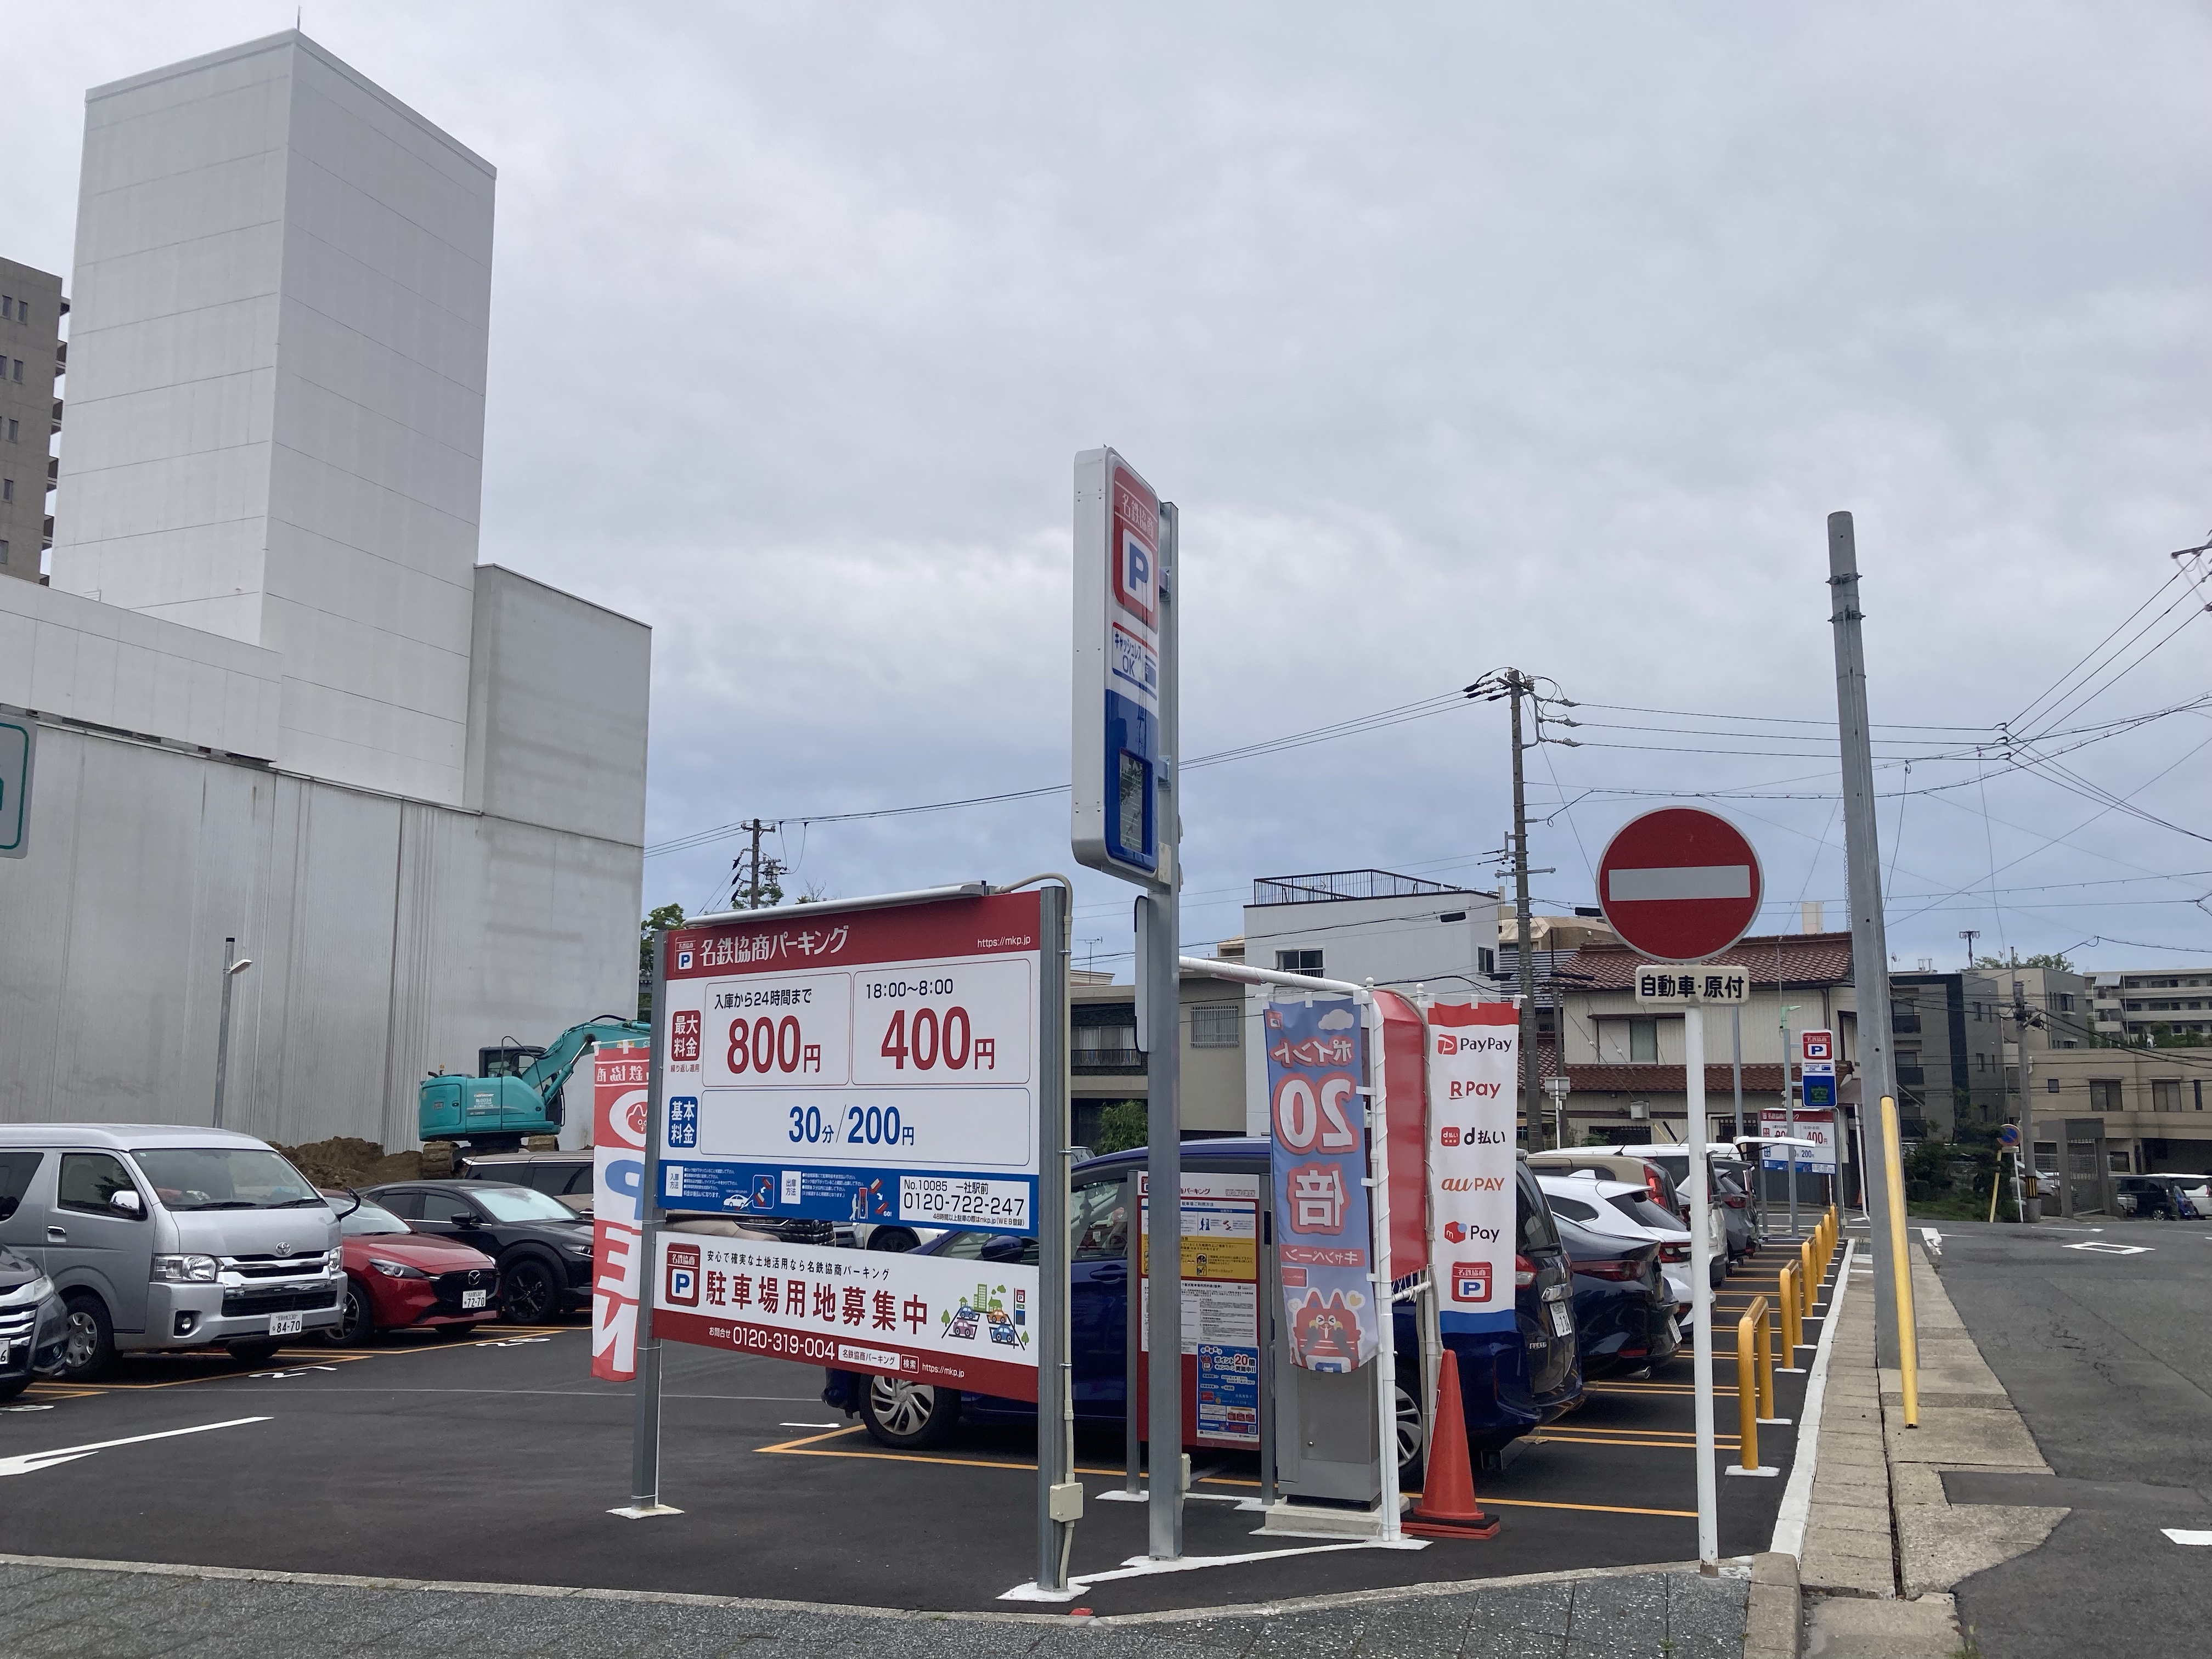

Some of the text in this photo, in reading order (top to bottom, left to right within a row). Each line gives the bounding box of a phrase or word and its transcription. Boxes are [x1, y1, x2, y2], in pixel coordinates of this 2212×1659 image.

[1121, 493, 1154, 540] 名鉄協商
[1129, 541, 1149, 591] P
[1115, 630, 1141, 663] キャッシュレス
[1122, 654, 1135, 678] OK
[699, 925, 849, 967] 名鉄協商パーキング
[977, 934, 1031, 949] https://mkp.jp
[681, 954, 690, 968] P
[1641, 974, 1745, 998] 自動車・原付
[714, 988, 812, 1010] 入庫から24時間まで
[674, 1014, 698, 1035] 最大
[673, 1036, 698, 1058] 料金
[727, 1015, 821, 1074] 800円
[881, 1006, 995, 1070] 400円
[1460, 1037, 1512, 1053] PayPay
[1811, 1046, 1824, 1055] P
[1450, 1080, 1502, 1099] R Pay
[671, 1101, 695, 1121] 基本
[671, 1123, 695, 1144] 料金
[1464, 1127, 1506, 1146] d払い
[786, 1187, 797, 1197] 方法
[904, 1179, 989, 1195] No.10085 一社駅前
[1441, 1177, 1505, 1192] au PAY
[904, 1192, 1024, 1216] 0120-722-247
[1470, 1225, 1500, 1243] Pay
[672, 1254, 695, 1266] 名鉄協商
[707, 1250, 890, 1281] 安心で確実な土地活用なら名鉄協商パーキング
[675, 1273, 690, 1294] P
[1463, 1282, 1481, 1295] P
[467, 1297, 485, 1307] 72-70
[706, 1270, 928, 1335] 駐車場用地募集中
[276, 1320, 300, 1333] 84-70
[709, 1326, 835, 1360] お問合せ 0120-319-004
[842, 1348, 895, 1365] 名鉄協商パーキング
[902, 1358, 917, 1370] 検索
[922, 1362, 965, 1378] https://mkp.jp
